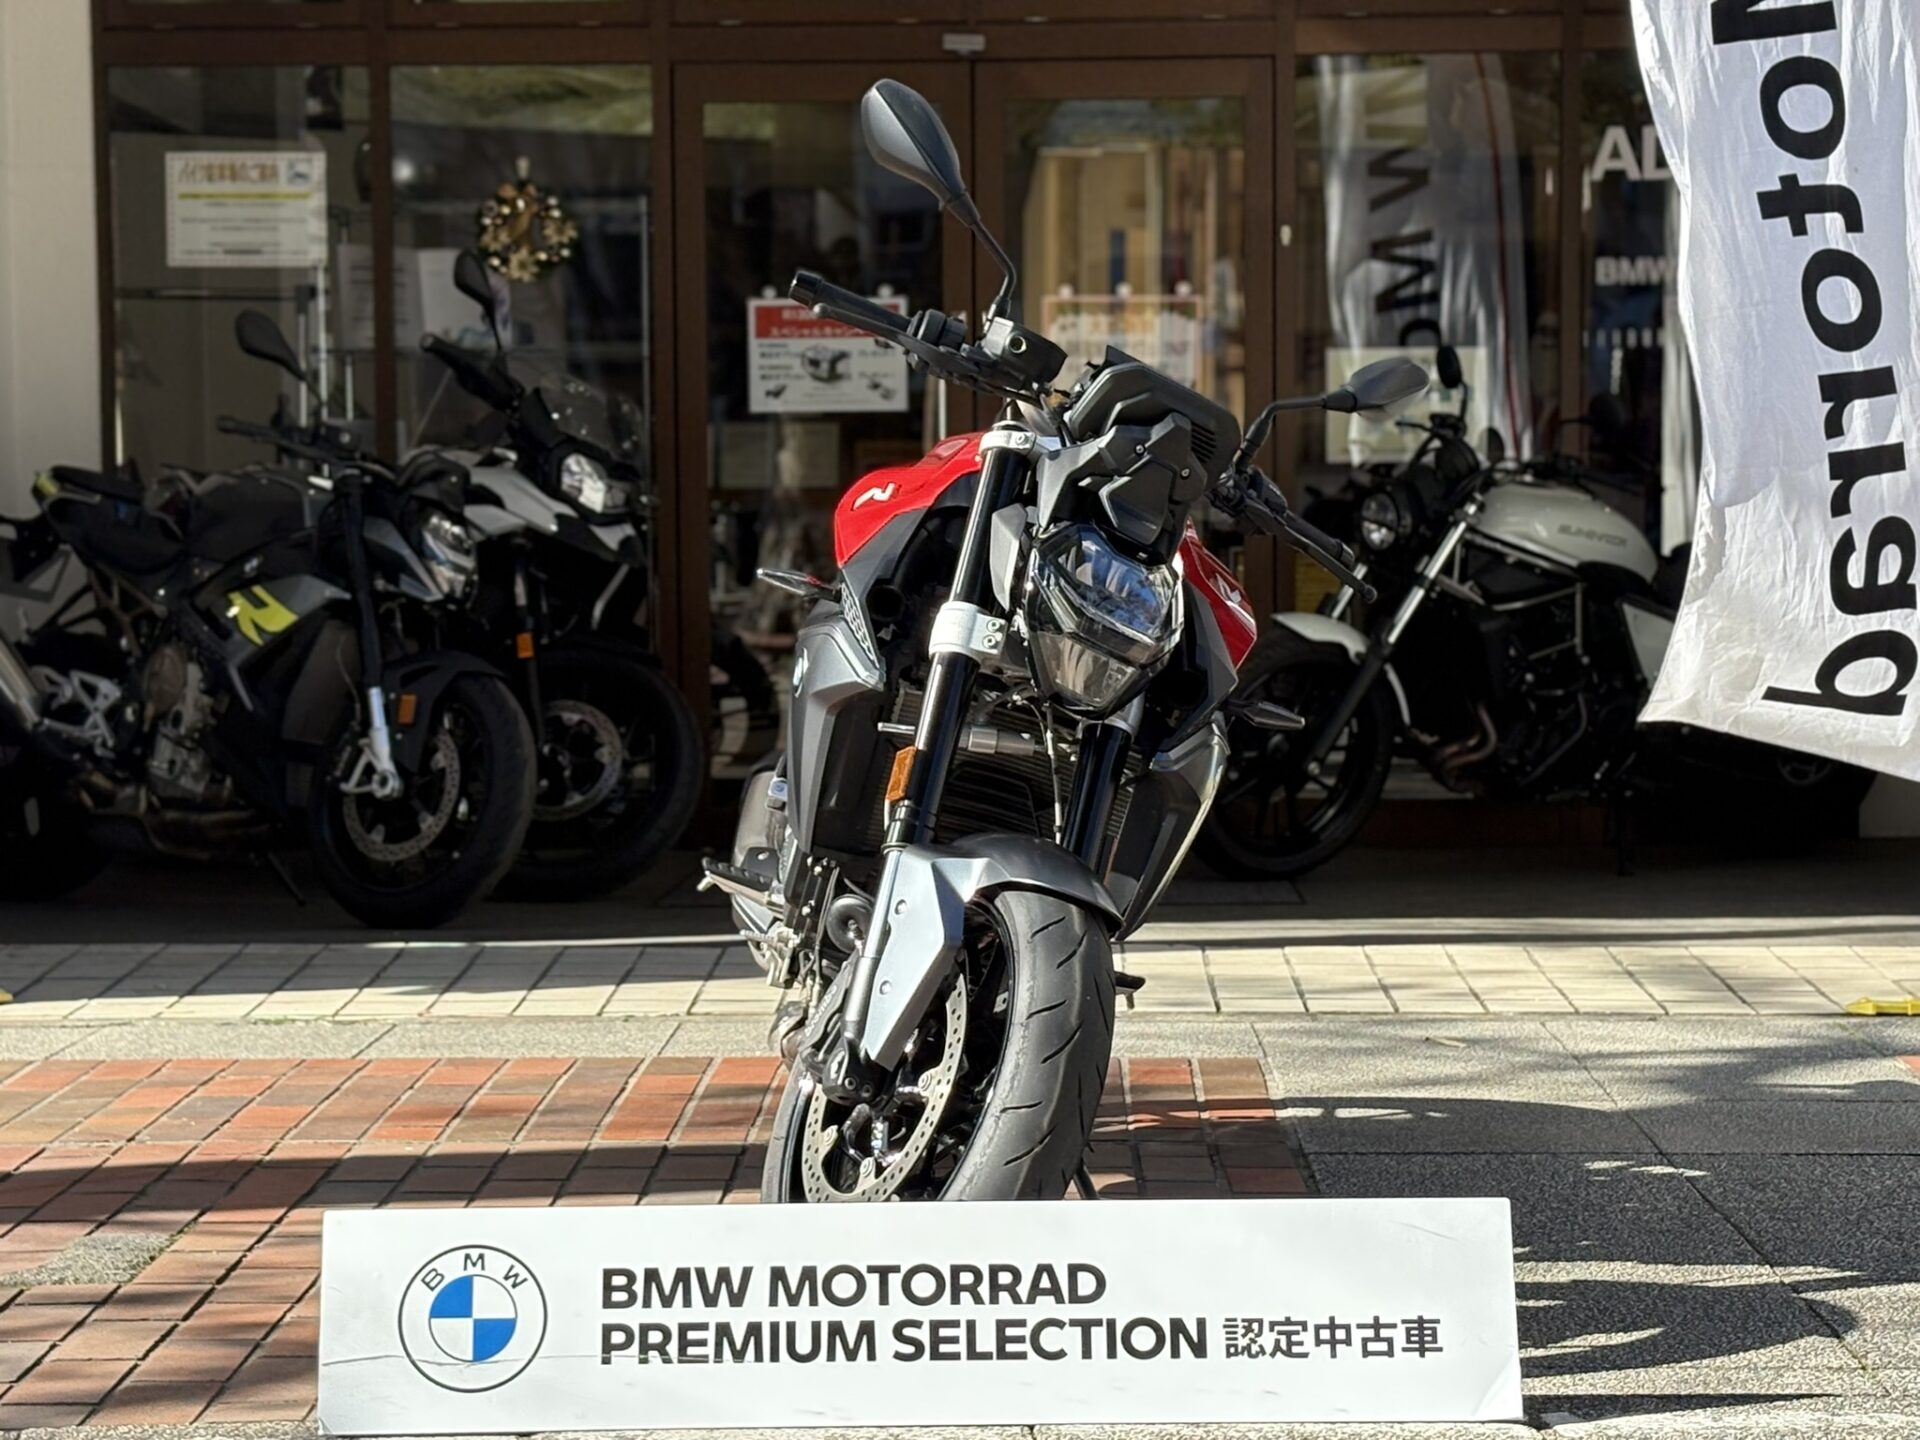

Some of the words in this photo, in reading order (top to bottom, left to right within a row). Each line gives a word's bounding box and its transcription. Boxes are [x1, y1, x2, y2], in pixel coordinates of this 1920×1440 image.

[420, 1252, 529, 1292] BMW
[602, 1265, 753, 1309] BMW
[768, 1263, 1107, 1307] MOTORRAD
[600, 1320, 877, 1365] PREMIUM
[892, 1317, 1208, 1362] SELECTION
[1223, 1315, 1444, 1359] 認定中古車
